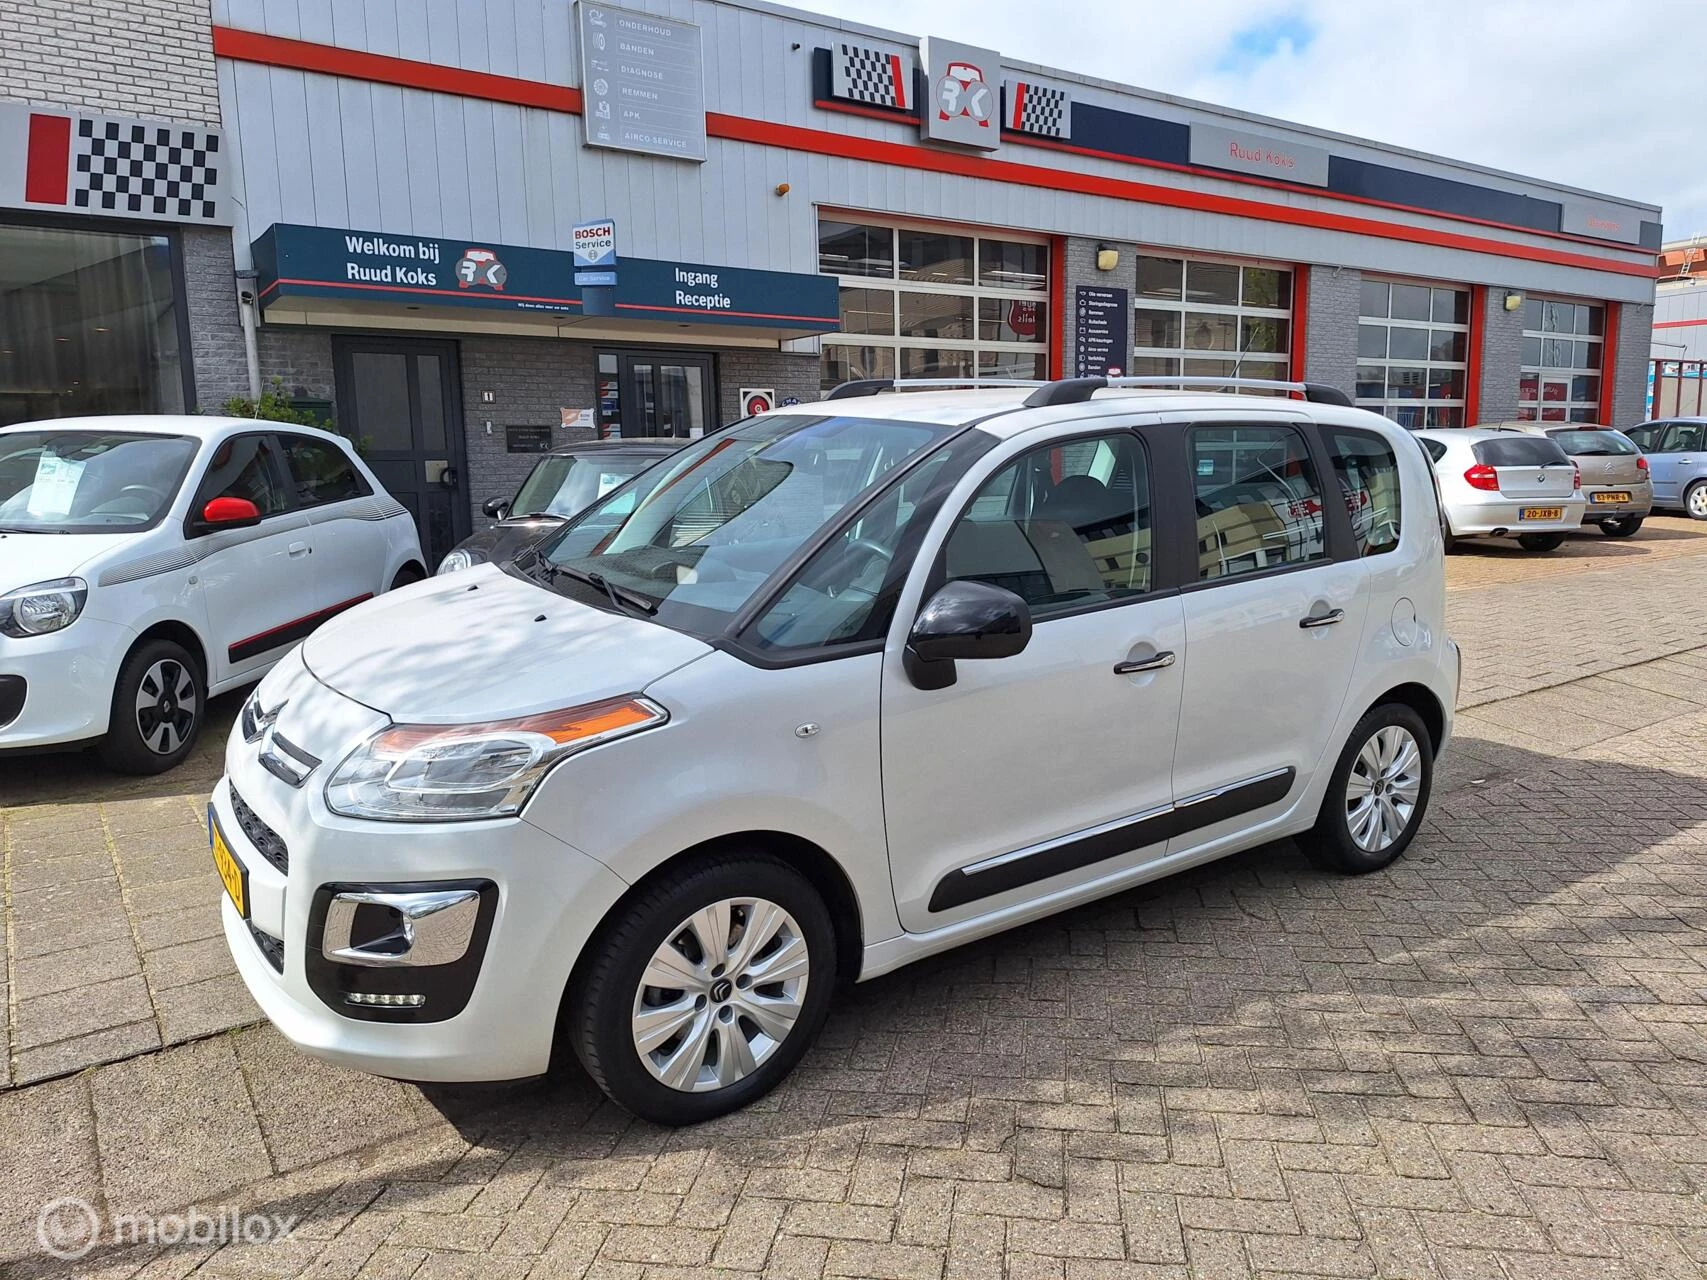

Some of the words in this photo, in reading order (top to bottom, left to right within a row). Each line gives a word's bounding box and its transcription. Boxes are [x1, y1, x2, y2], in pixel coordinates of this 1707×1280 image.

[619, 19, 672, 37] ONDERHOUD
[620, 43, 655, 56] BANDEN
[621, 65, 664, 80] DIAGNOSE
[622, 88, 659, 100] REMMEN
[624, 110, 641, 120] APK
[1230, 142, 1261, 162] Ruud
[575, 226, 611, 240] BOSCH
[345, 236, 415, 259] Welkom
[418, 242, 440, 264] bij
[575, 239, 612, 250] Service
[346, 263, 392, 283] Ruud
[396, 267, 437, 286] Koks
[675, 267, 719, 289] Ingang
[675, 290, 731, 310] Receptie
